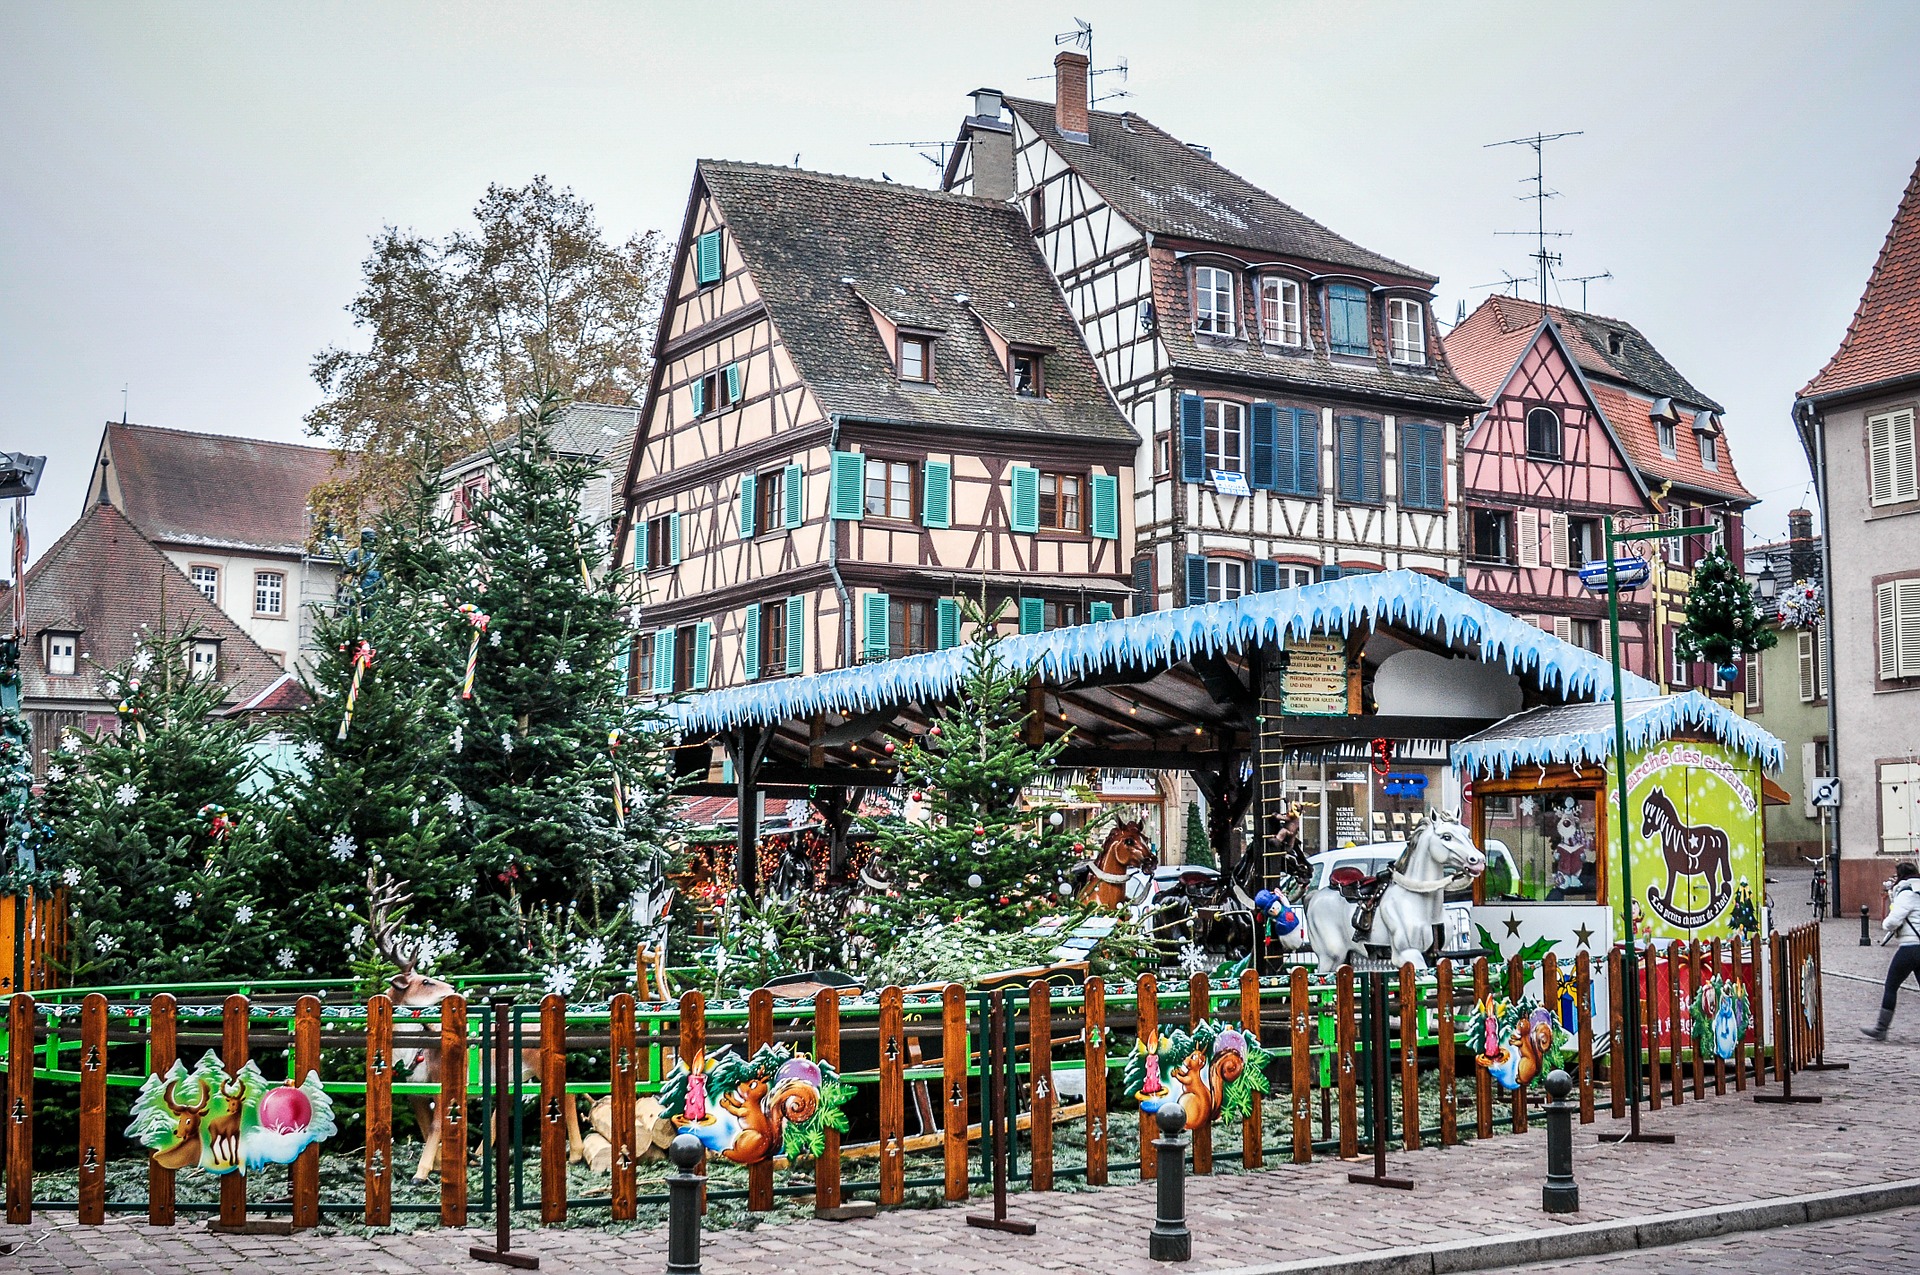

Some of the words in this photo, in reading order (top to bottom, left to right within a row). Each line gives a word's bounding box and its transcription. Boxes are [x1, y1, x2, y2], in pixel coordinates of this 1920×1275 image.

[1611, 748, 1669, 806] arché
[1672, 746, 1700, 764] des
[1703, 755, 1756, 812] enfants
